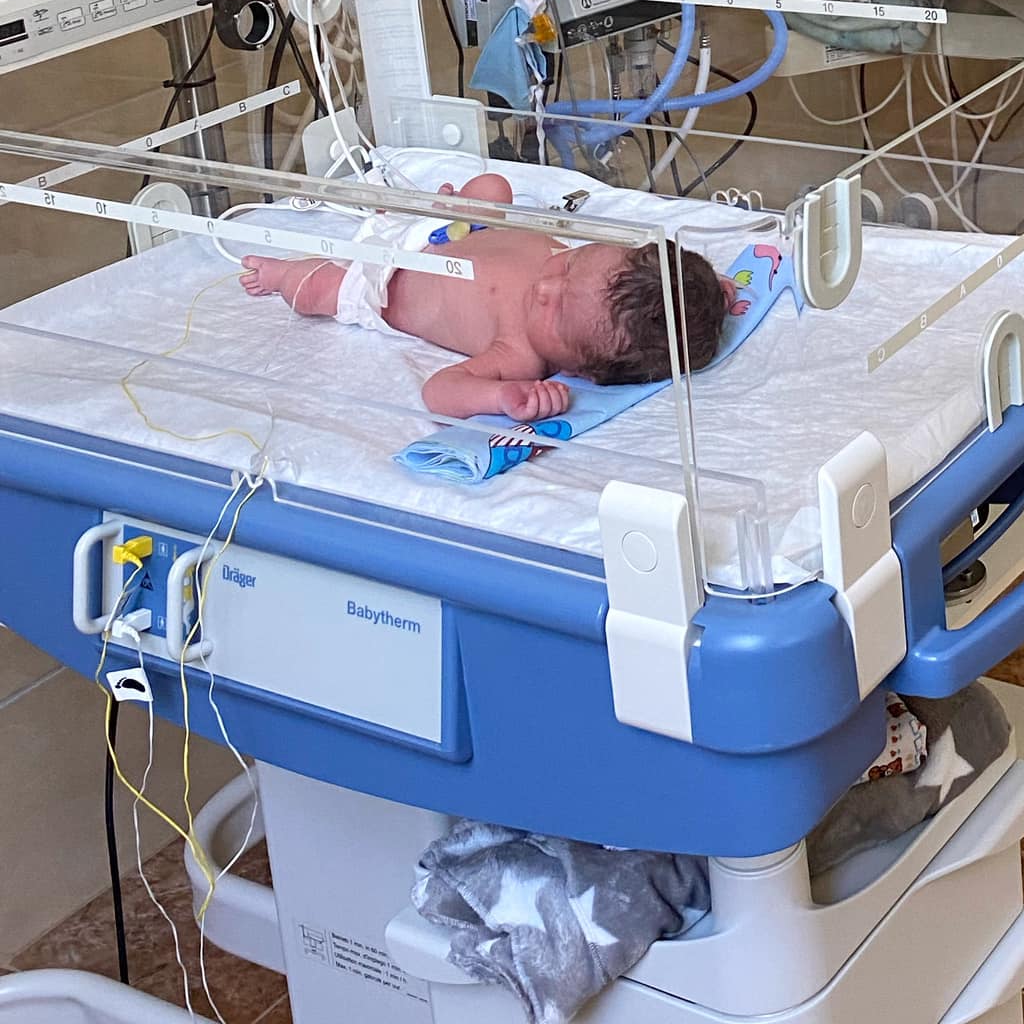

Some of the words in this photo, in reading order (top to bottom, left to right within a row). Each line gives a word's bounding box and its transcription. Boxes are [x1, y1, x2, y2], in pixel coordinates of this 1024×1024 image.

[775, 0, 782, 9] 5
[823, 2, 834, 14] 10
[873, 6, 886, 17] 15
[925, 9, 938, 21] 20
[38, 176, 47, 188] B
[239, 102, 247, 113] B
[283, 85, 290, 96] C
[222, 564, 256, 588] Dräger
[347, 600, 421, 634] Babytherm
